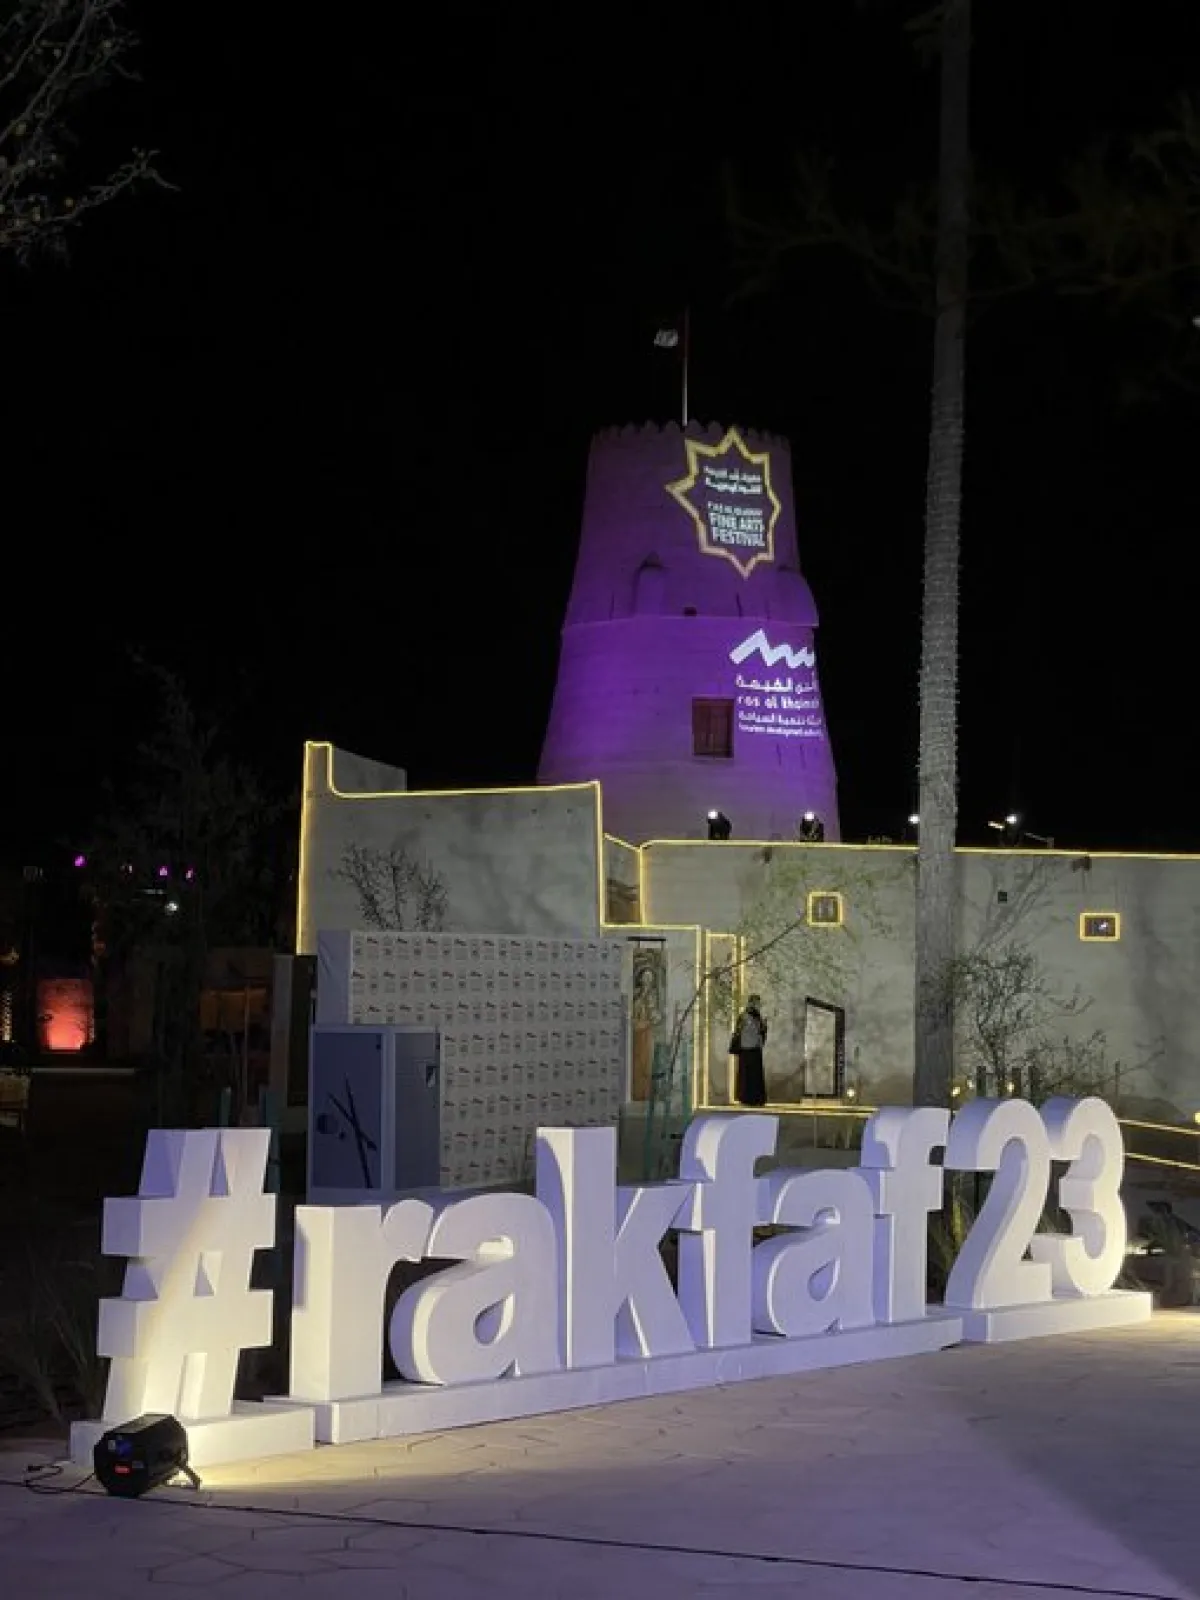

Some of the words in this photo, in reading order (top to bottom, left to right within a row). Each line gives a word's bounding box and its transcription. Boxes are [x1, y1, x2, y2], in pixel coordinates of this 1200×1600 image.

[709, 513, 737, 530] FINE
[712, 526, 766, 547] FESTIVAL
[98, 1096, 1126, 1421] #rakfaf23
